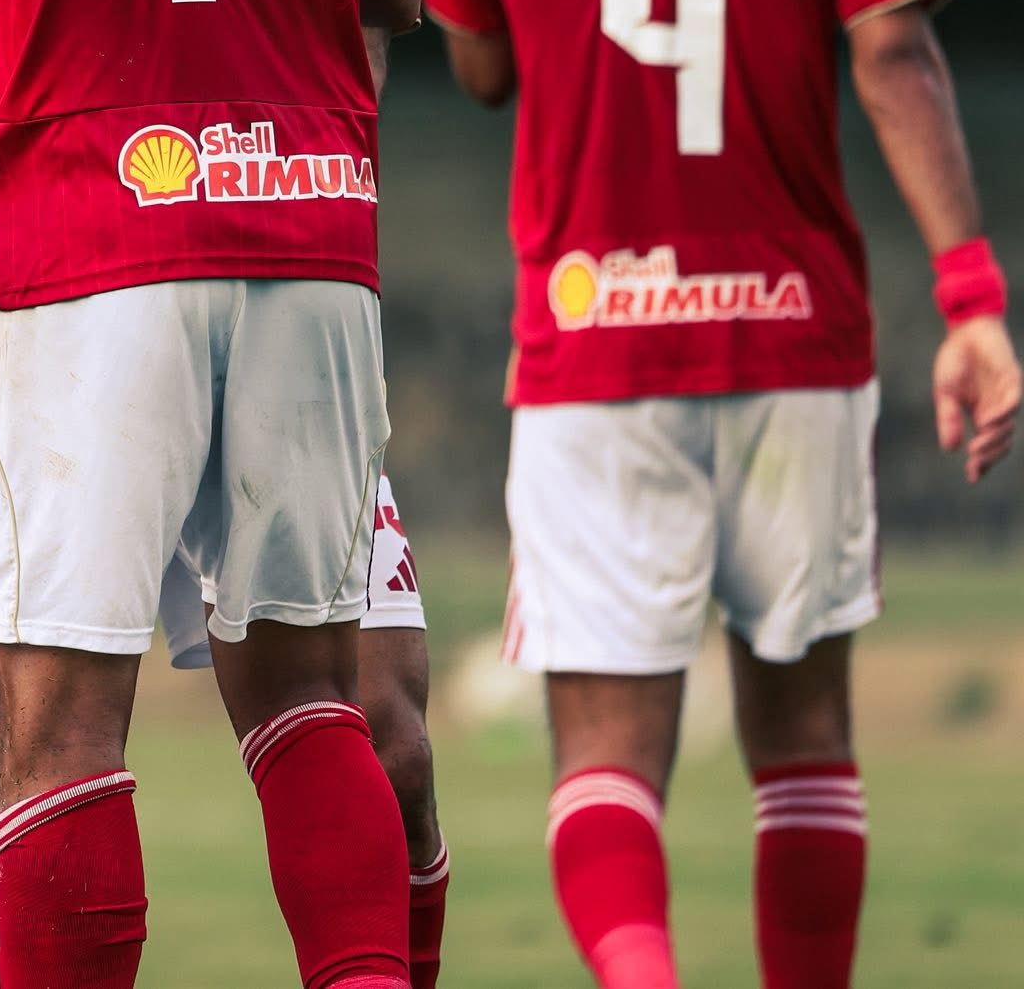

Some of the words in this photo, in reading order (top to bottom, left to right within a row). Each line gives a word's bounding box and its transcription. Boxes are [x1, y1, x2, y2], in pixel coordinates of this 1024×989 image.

[204, 125, 272, 156] Shell
[208, 157, 377, 199] RIMULA
[606, 282, 805, 317] RIMULA
